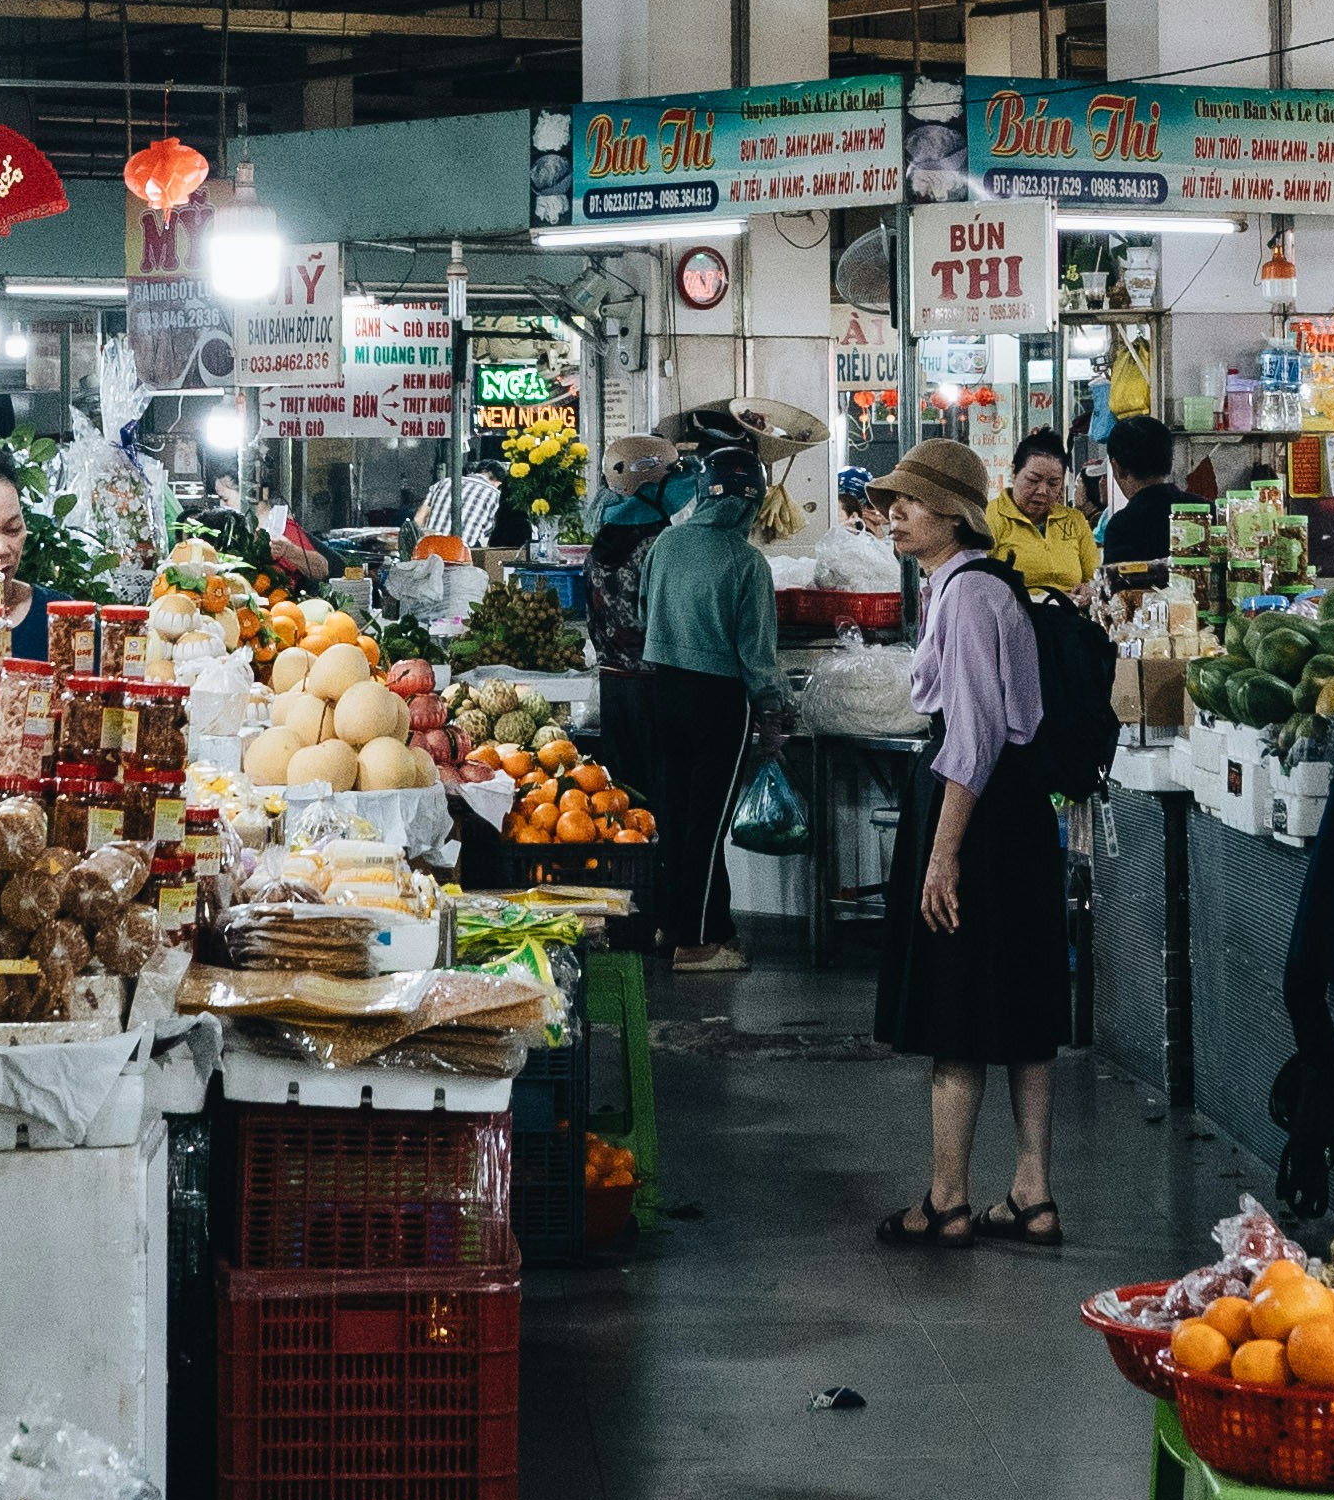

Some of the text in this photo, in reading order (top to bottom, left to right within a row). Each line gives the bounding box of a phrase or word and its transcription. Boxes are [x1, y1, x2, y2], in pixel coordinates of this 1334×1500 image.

[986, 90, 1163, 161] Bún Thi
[586, 107, 715, 178] Bún Thi
[785, 130, 809, 158] BÁNH
[811, 132, 834, 155] CANH
[1195, 132, 1215, 158] BÚN
[1251, 134, 1278, 161] BÁNH
[1281, 139, 1307, 162] CANH
[813, 167, 836, 196] BÁNH
[993, 175, 1158, 198] ĐT: 0623.817.629 0986.364.813
[1248, 172, 1273, 200] VÀNG
[1284, 174, 1311, 201] BÁNH
[589, 195, 602, 213] ĐT:
[950, 213, 1004, 252] BÚN
[931, 256, 1023, 300] THI
[269, 311, 294, 344] BÁNH
[355, 317, 381, 338] CANH
[427, 321, 450, 338] HEO
[250, 352, 329, 373] 033.8462.836
[403, 374, 426, 389] NEM
[280, 391, 427, 418] THỊT BÚN THỊT
